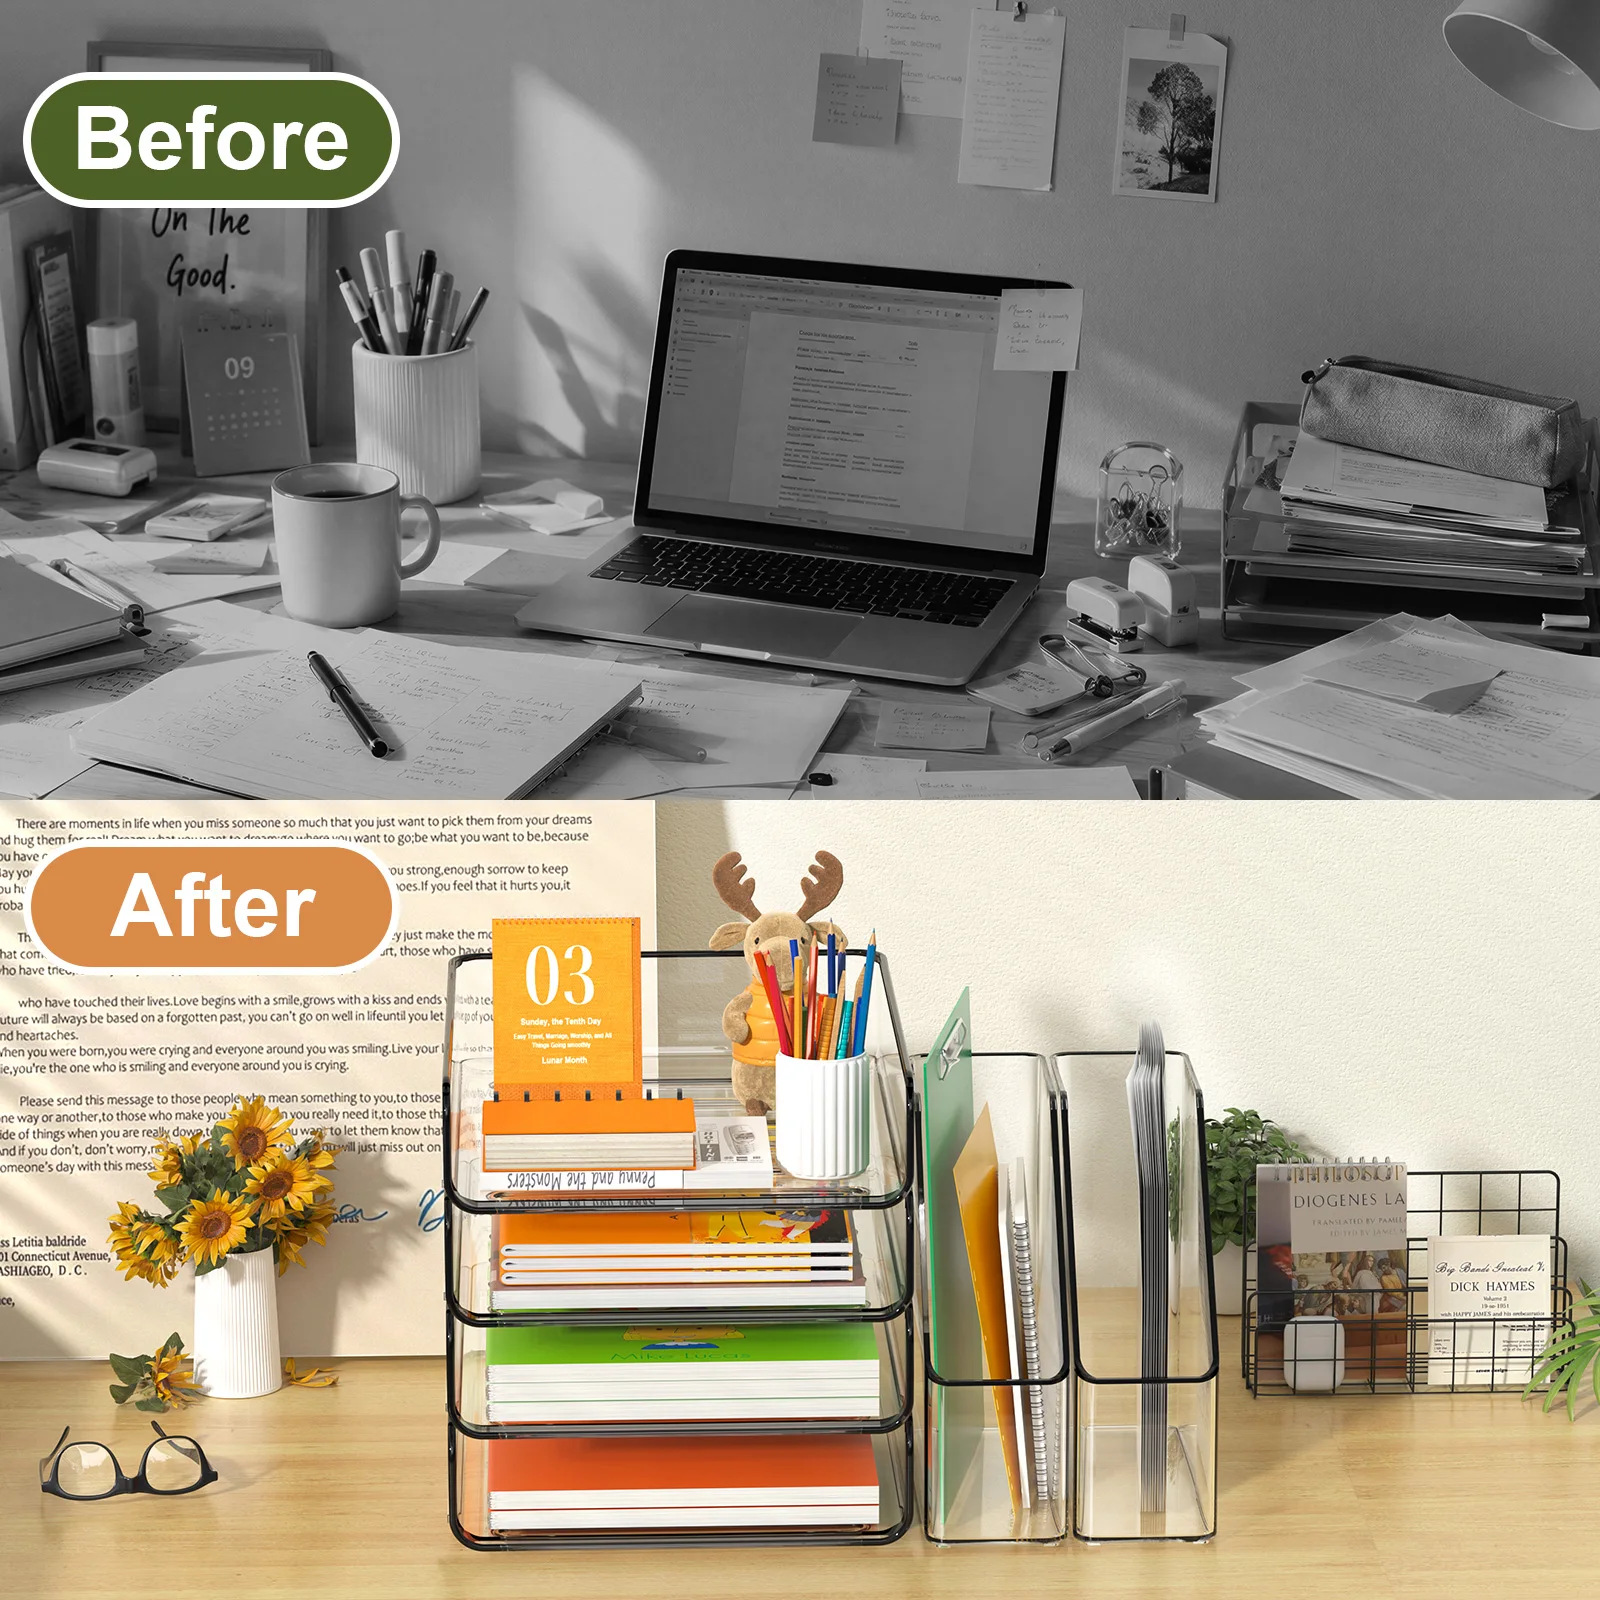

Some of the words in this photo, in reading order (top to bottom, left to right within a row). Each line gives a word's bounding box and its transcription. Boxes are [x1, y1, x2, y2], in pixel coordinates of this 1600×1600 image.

[152, 207, 187, 238] On
[167, 253, 235, 297] Good.
[224, 356, 255, 379] 09
[16, 817, 47, 829] There
[48, 820, 66, 829] are
[68, 818, 120, 828] moments
[121, 816, 132, 828] in
[133, 816, 150, 828] life
[151, 816, 182, 828] when
[183, 819, 204, 831] you
[205, 816, 230, 828] miss
[231, 819, 281, 827] someone
[282, 819, 296, 827] so
[298, 815, 328, 827] much
[330, 815, 352, 827] that
[354, 818, 374, 830] you
[376, 815, 396, 830] just
[397, 816, 425, 826] want
[427, 816, 440, 826] to
[441, 814, 464, 829] pick
[465, 814, 494, 826] them
[496, 814, 523, 826] from
[524, 817, 550, 829] your
[551, 813, 592, 825] dreams
[13, 833, 34, 848] hug
[36, 833, 66, 845] them
[352, 832, 381, 843] want
[382, 832, 396, 842] to
[429, 830, 458, 842] what
[459, 834, 480, 846] you
[481, 832, 510, 842] want
[512, 831, 524, 842] to
[486, 866, 525, 874] sorrow
[526, 864, 540, 874] to
[541, 862, 568, 878] keep
[430, 882, 451, 894] you
[452, 879, 473, 890] feel
[474, 878, 498, 890] that
[499, 878, 508, 890] it
[509, 878, 538, 890] hurts
[402, 928, 423, 943] just
[424, 927, 454, 939] make
[456, 927, 475, 939] the
[525, 944, 595, 1006] 03
[18, 996, 43, 1008] who
[44, 996, 70, 1008] have
[72, 996, 118, 1007] touched
[120, 995, 145, 1007] their
[200, 995, 236, 1010] begins
[237, 994, 262, 1006] with
[263, 998, 270, 1006] a
[336, 994, 361, 1006] with
[362, 997, 370, 1006] a
[371, 994, 392, 1005] kiss
[393, 993, 414, 1005] and
[415, 993, 442, 1005] ends
[520, 1017, 550, 1027] Sunday,
[551, 1017, 563, 1025] the
[565, 1017, 586, 1025] Tenth
[587, 1017, 602, 1026] Day
[15, 1028, 78, 1040] heartaches.
[26, 1048, 47, 1060] you
[48, 1047, 76, 1056] were
[128, 1047, 156, 1055] were
[158, 1043, 191, 1058] crying
[192, 1043, 212, 1055] and
[214, 1046, 264, 1058] everyone
[266, 1042, 304, 1054] around
[305, 1045, 326, 1057] you
[327, 1045, 350, 1054] was
[414, 1045, 440, 1057] your
[48, 1061, 67, 1072] the
[68, 1064, 90, 1072] one
[92, 1060, 116, 1072] who
[118, 1060, 127, 1072] is
[128, 1060, 166, 1075] smiling
[167, 1060, 188, 1072] and
[190, 1063, 240, 1075] everyone
[241, 1059, 280, 1071] around
[281, 1062, 302, 1074] you
[304, 1059, 312, 1070] is
[314, 1059, 349, 1074] crying.
[564, 1056, 588, 1064] Month
[19, 1094, 54, 1106] Please
[56, 1094, 82, 1106] send
[84, 1094, 104, 1105] this
[106, 1096, 154, 1108] message
[156, 1094, 168, 1105] to
[170, 1093, 201, 1104] those
[268, 1095, 298, 1104] mean
[300, 1091, 358, 1107] something
[358, 1092, 371, 1103] to
[410, 1090, 441, 1102] those
[54, 1160, 75, 1175] day
[77, 1159, 101, 1171] with
[104, 1159, 124, 1171] this
[507, 1172, 562, 1190] Monsters
[567, 1172, 586, 1190] the
[591, 1171, 614, 1190] and
[619, 1170, 656, 1189] Penny
[1294, 1193, 1377, 1208] DIOGENES
[1385, 1192, 1405, 1205] LA
[1312, 1218, 1363, 1226] TRANSLATED
[1373, 1228, 1397, 1236] JAMES
[12, 1235, 44, 1247] Letitia
[44, 1235, 86, 1246] baldride
[10, 1250, 70, 1261] Connecticut
[1435, 1262, 1456, 1276] Big
[1450, 1282, 1480, 1292] DICK
[1486, 1281, 1535, 1291] HAYMES
